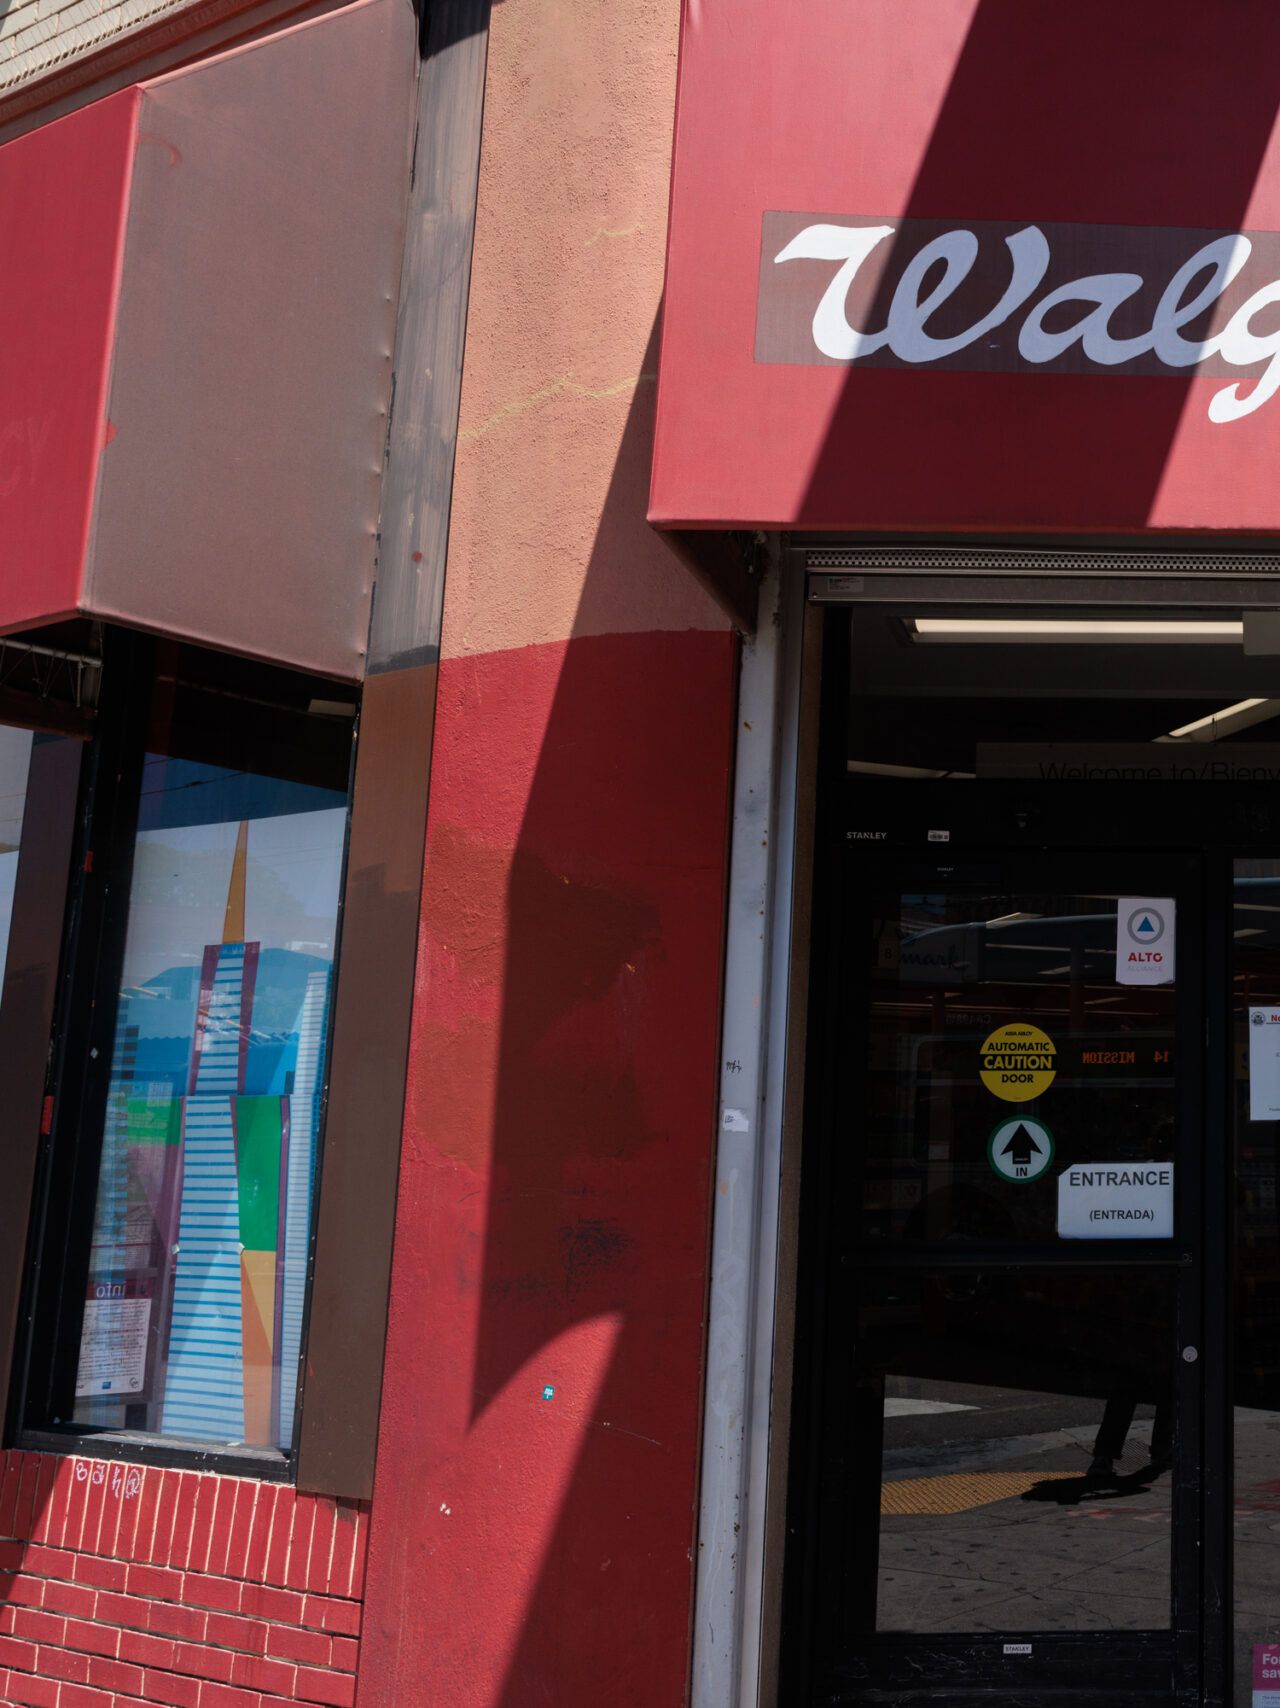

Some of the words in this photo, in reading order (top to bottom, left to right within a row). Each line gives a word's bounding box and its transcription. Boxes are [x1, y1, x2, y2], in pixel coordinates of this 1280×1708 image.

[845, 831, 888, 840] STANLEY
[1128, 952, 1163, 962] ALTO
[987, 1042, 1050, 1051] AUTOMATIC
[983, 1055, 1053, 1070] CAUTION
[1001, 1073, 1034, 1083] DOOR
[1015, 1166, 1028, 1177] IN
[1069, 1171, 1170, 1187] ENTRANCE
[1089, 1209, 1154, 1222] (ENTRADA)
